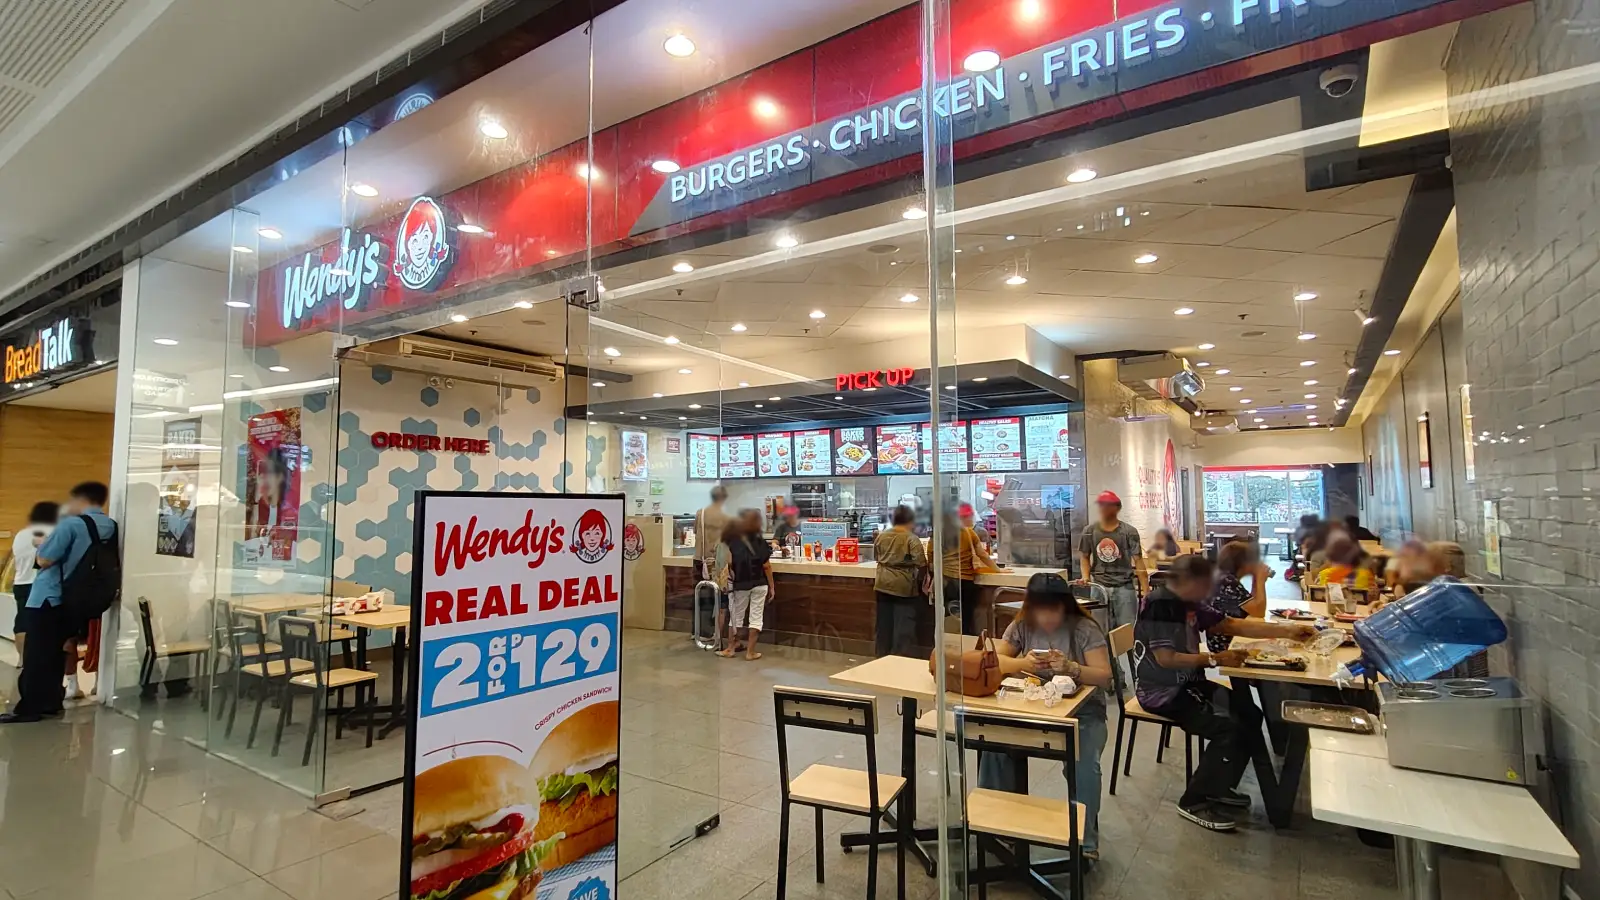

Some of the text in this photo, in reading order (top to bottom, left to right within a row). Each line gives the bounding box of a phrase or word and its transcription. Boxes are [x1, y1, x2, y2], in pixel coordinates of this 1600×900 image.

[671, 7, 1185, 203] BURGERS CHICKEN FRIES
[283, 228, 380, 329] Wendy's
[836, 367, 914, 391] PICK UP
[371, 431, 490, 454] ORDER HERE
[434, 508, 565, 577] Wendy's
[424, 574, 618, 627] REAL DEAL
[431, 642, 481, 709] 2
[487, 636, 507, 696] FOR
[534, 686, 613, 731] CRISPY CHICKEN SANDWICH
